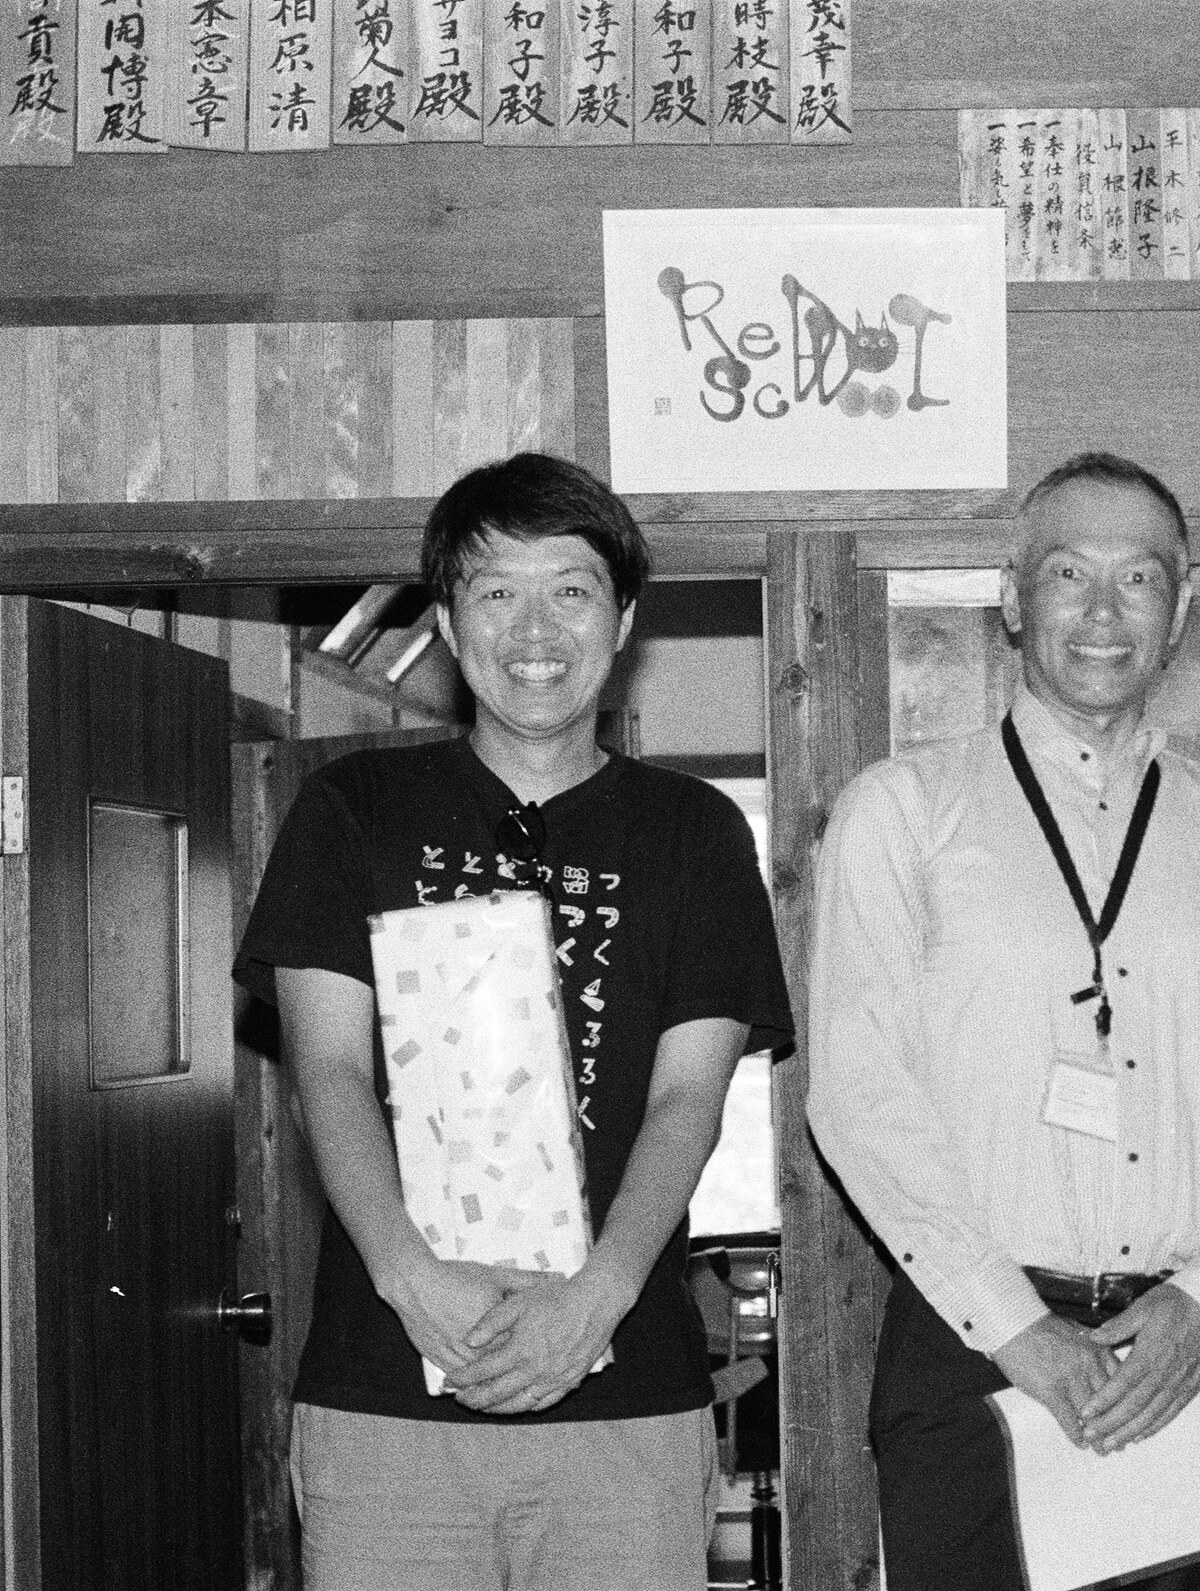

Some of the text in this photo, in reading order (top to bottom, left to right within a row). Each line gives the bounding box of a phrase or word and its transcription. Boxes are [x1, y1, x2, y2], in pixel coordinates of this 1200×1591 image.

[488, 2, 555, 127] 和子殿
[642, 2, 707, 128] 和子殿
